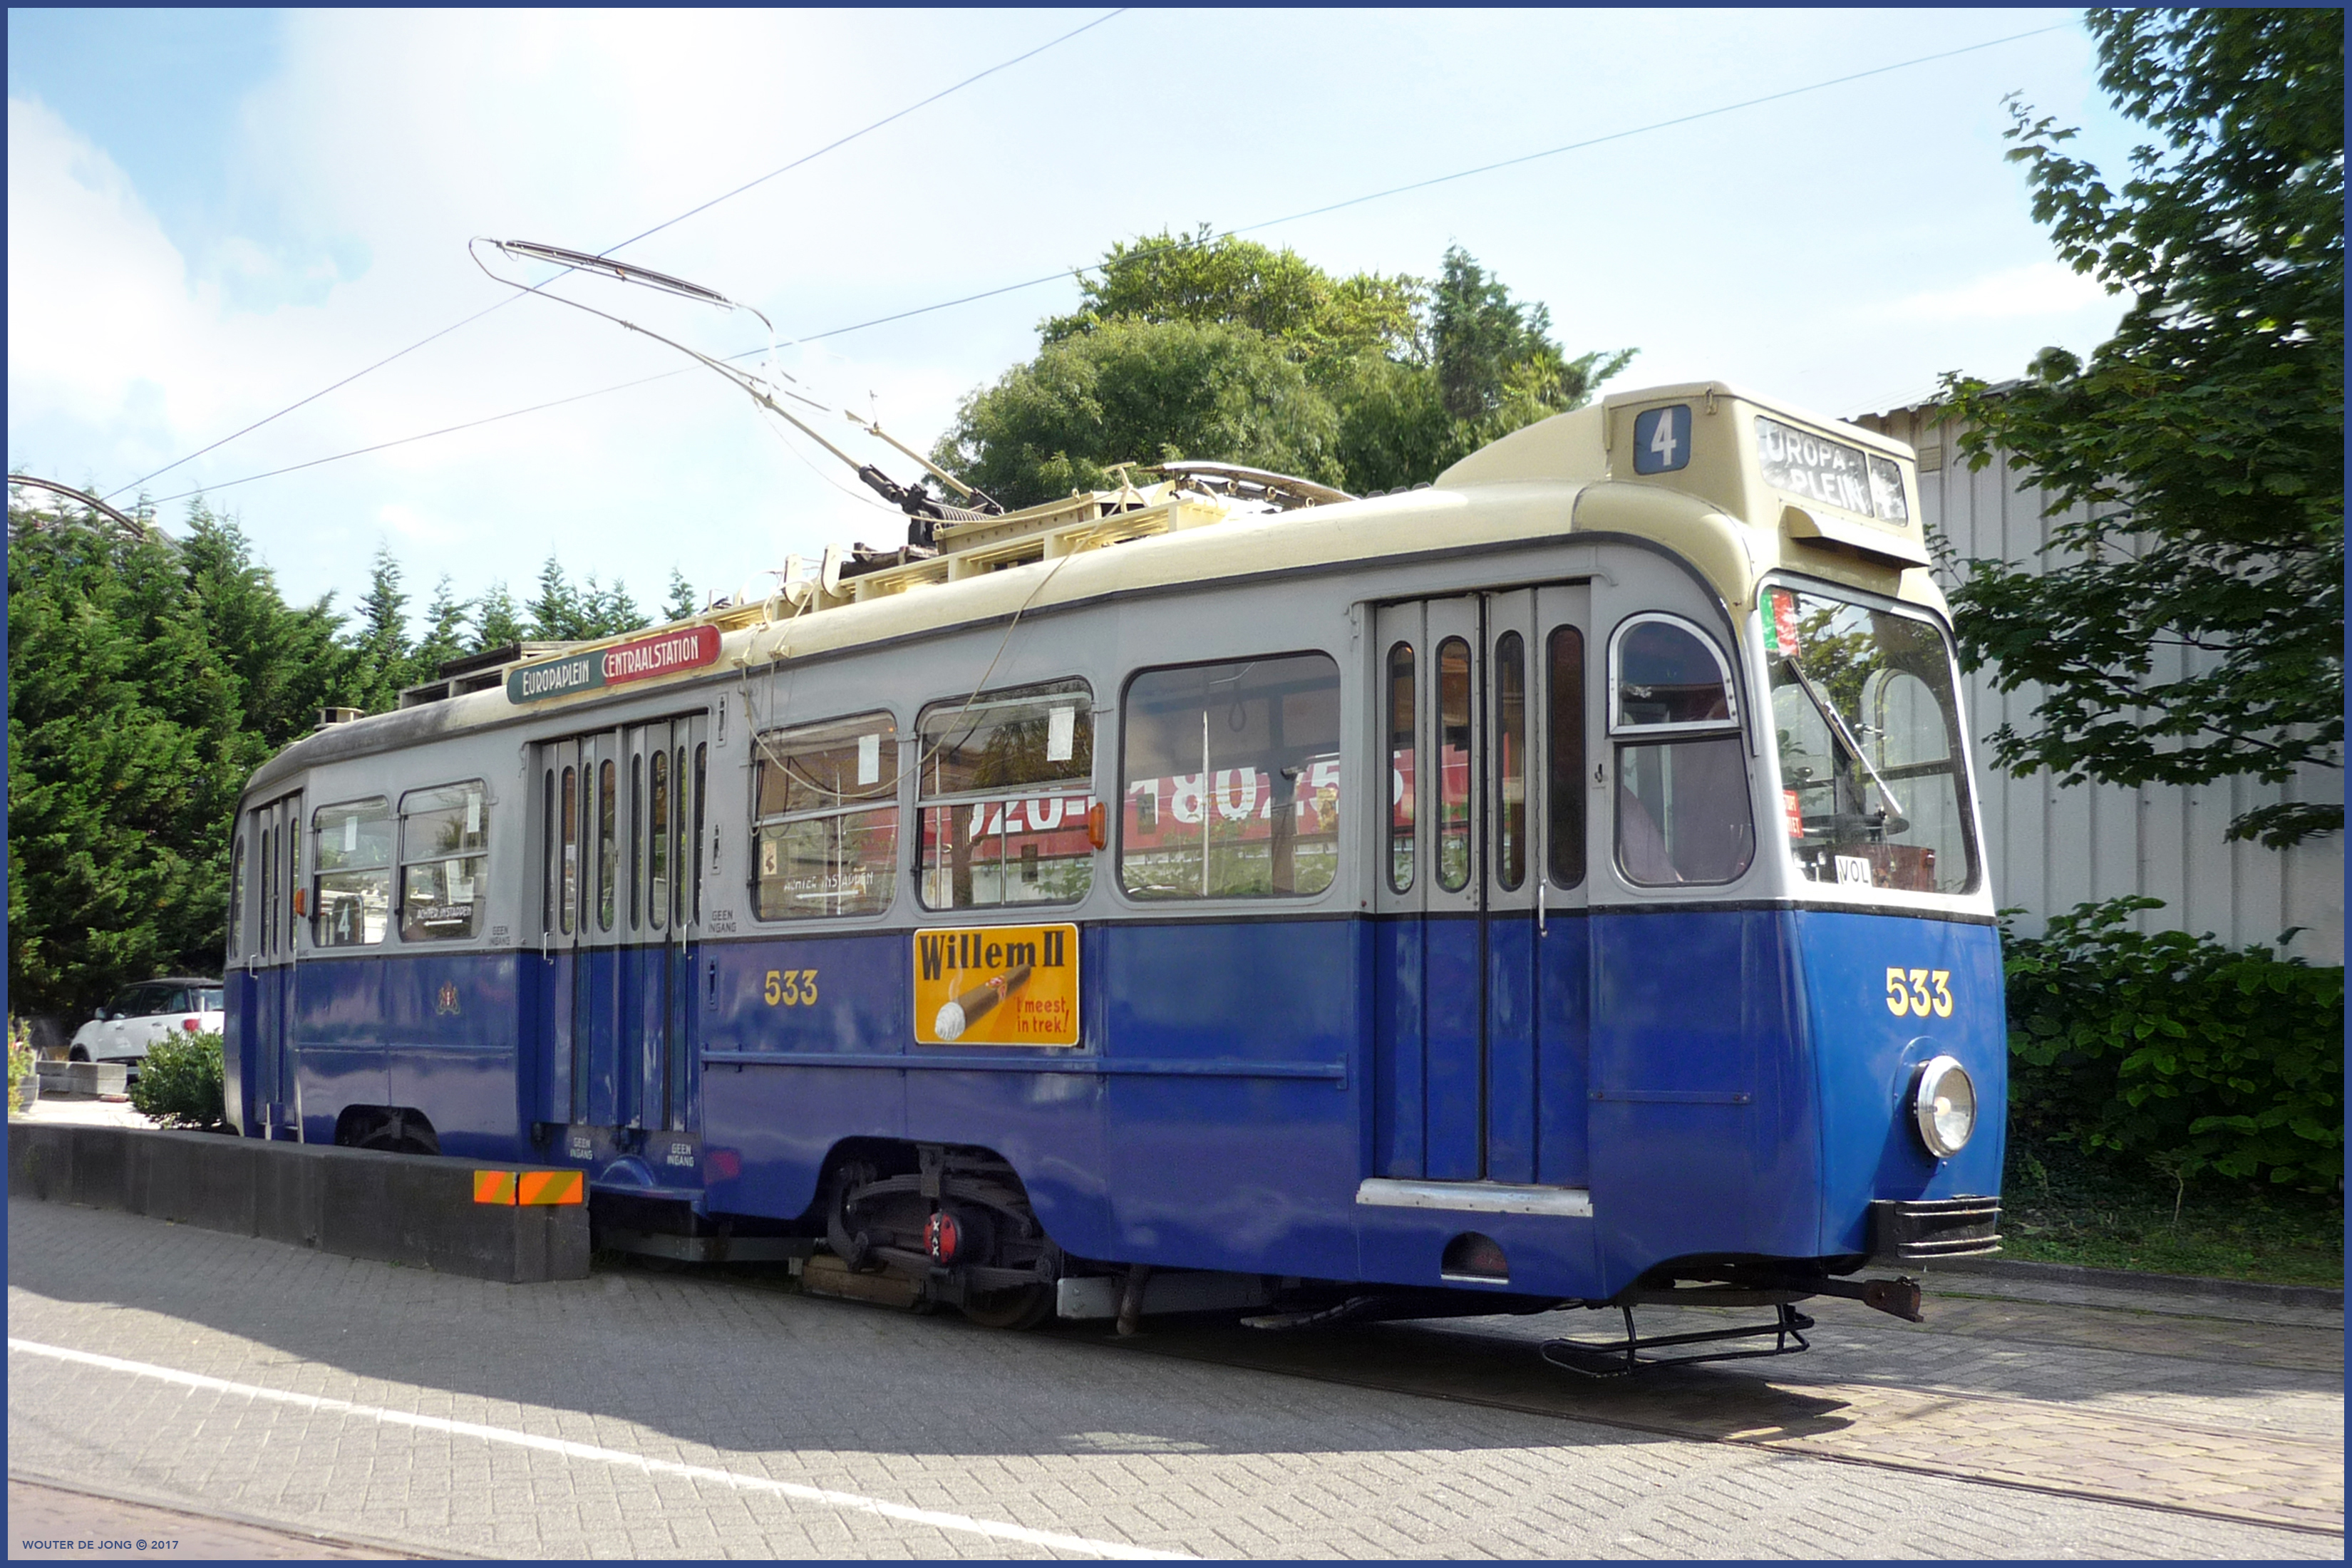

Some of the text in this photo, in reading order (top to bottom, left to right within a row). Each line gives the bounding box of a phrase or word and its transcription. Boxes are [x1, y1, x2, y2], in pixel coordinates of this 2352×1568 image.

[1651, 408, 1676, 466] 4
[1789, 468, 1867, 515] PLEIN
[522, 635, 699, 696] EUROPAPLEIN CENTRAALSTATION
[1838, 858, 1869, 884] VOL
[338, 902, 351, 941] 4
[708, 922, 736, 933] INGANG
[712, 909, 733, 921] GEEN
[919, 930, 1065, 981] Willem II
[764, 969, 818, 1006] 533
[1886, 967, 1953, 1018] 533
[1017, 1009, 1070, 1033] in trek!
[570, 1148, 593, 1160] INGANG
[573, 1137, 591, 1148] GEEN
[671, 1143, 691, 1155] GEEN
[666, 1155, 694, 1167] INGANG
